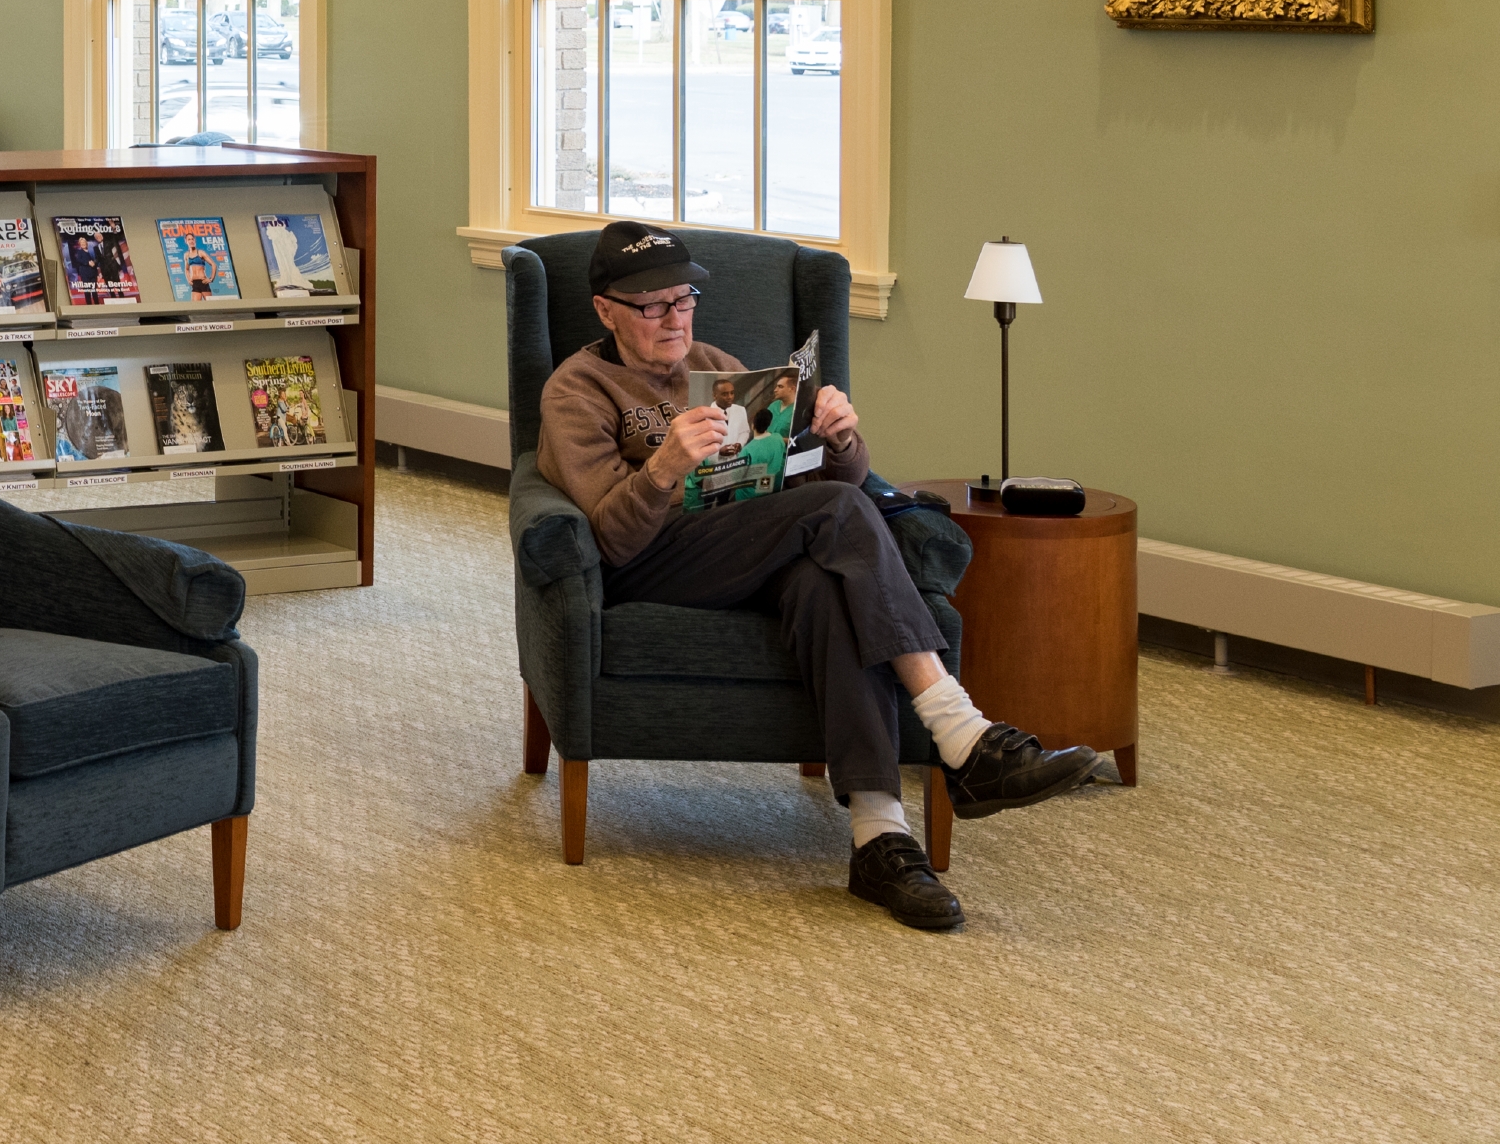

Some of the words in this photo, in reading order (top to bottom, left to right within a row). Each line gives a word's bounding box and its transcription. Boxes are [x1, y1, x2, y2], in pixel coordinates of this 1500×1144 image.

[201, 236, 225, 245] LEAN
[71, 281, 96, 289] Hillary
[108, 280, 133, 288] Bernie
[176, 324, 208, 332] RUNNER'S
[246, 361, 286, 376] Southern
[286, 360, 315, 375] Living
[158, 369, 203, 381] Smithsonian
[46, 377, 75, 392] SKY
[251, 376, 286, 388] Spring
[288, 374, 313, 385] Style
[281, 462, 314, 470] SOUTHERN
[697, 467, 714, 475] GROW
[90, 476, 126, 484] TELESCOPE
[6, 483, 37, 491] KNITTING
